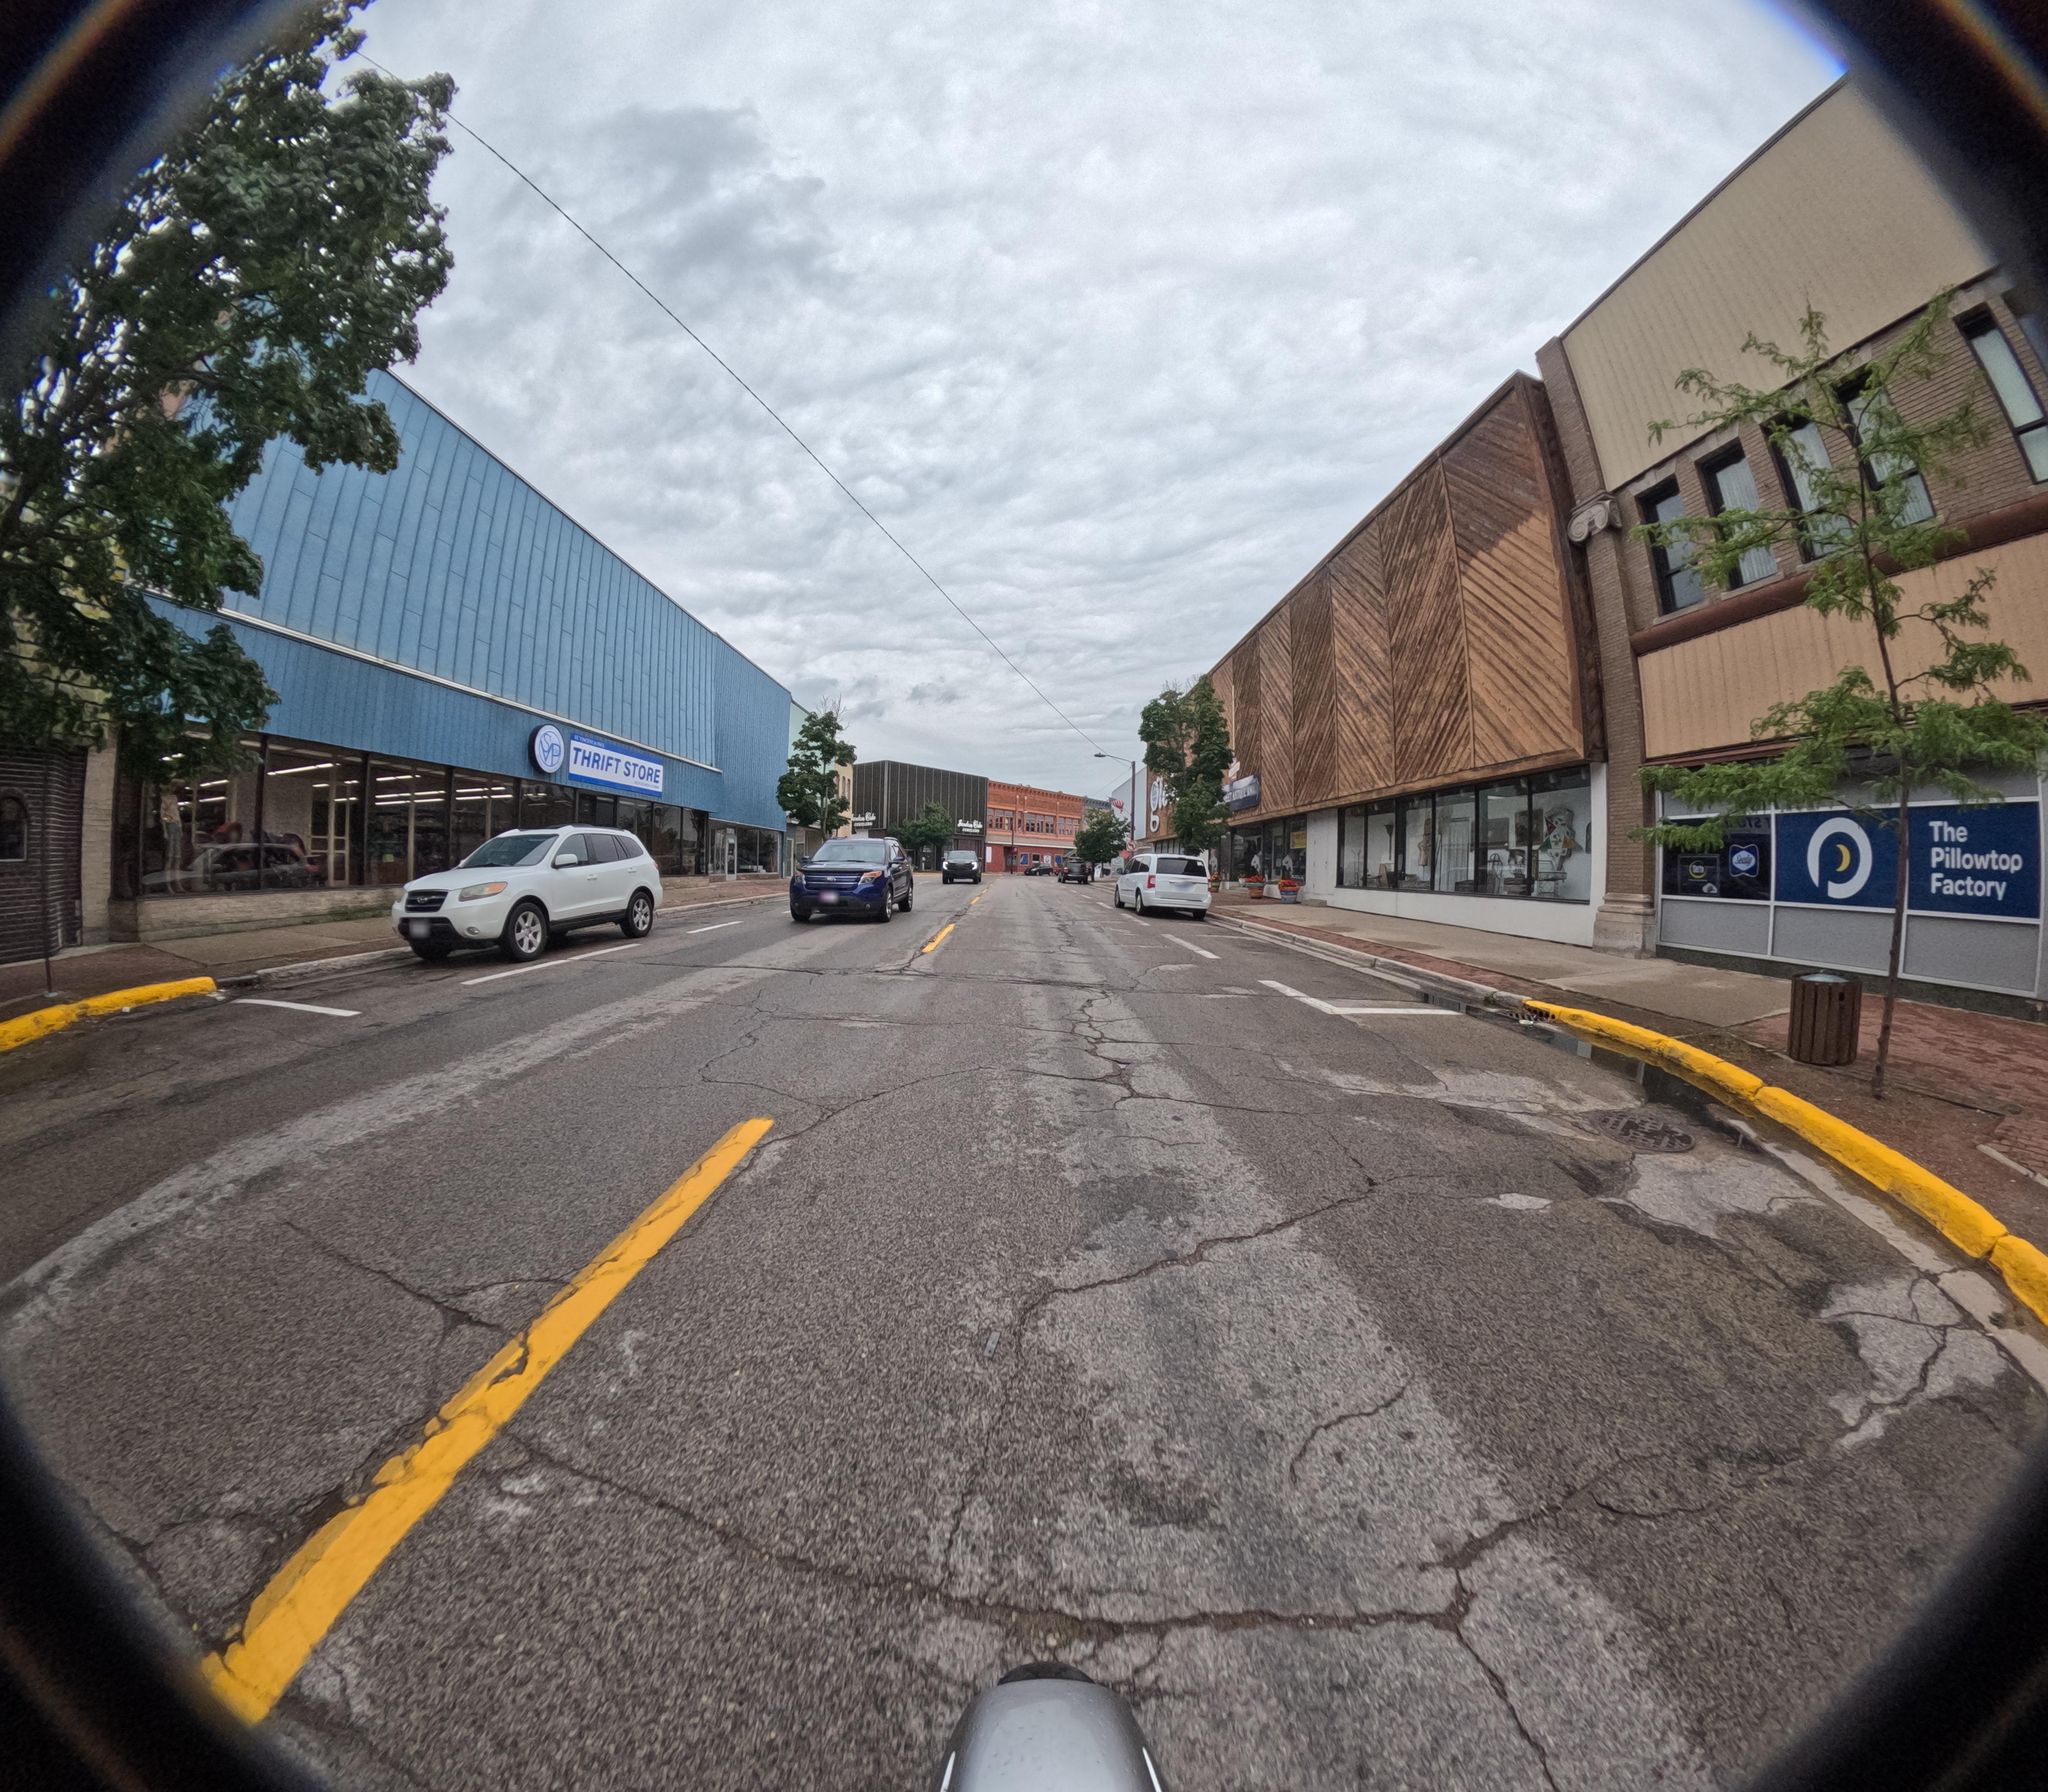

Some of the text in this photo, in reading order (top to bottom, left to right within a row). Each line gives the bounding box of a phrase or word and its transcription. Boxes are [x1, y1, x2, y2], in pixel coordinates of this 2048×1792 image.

[573, 747, 661, 784] THRIFT STORE
[1928, 820, 1968, 842] The
[1931, 846, 2023, 874] Pillowtop
[1931, 872, 2007, 901] Factory
